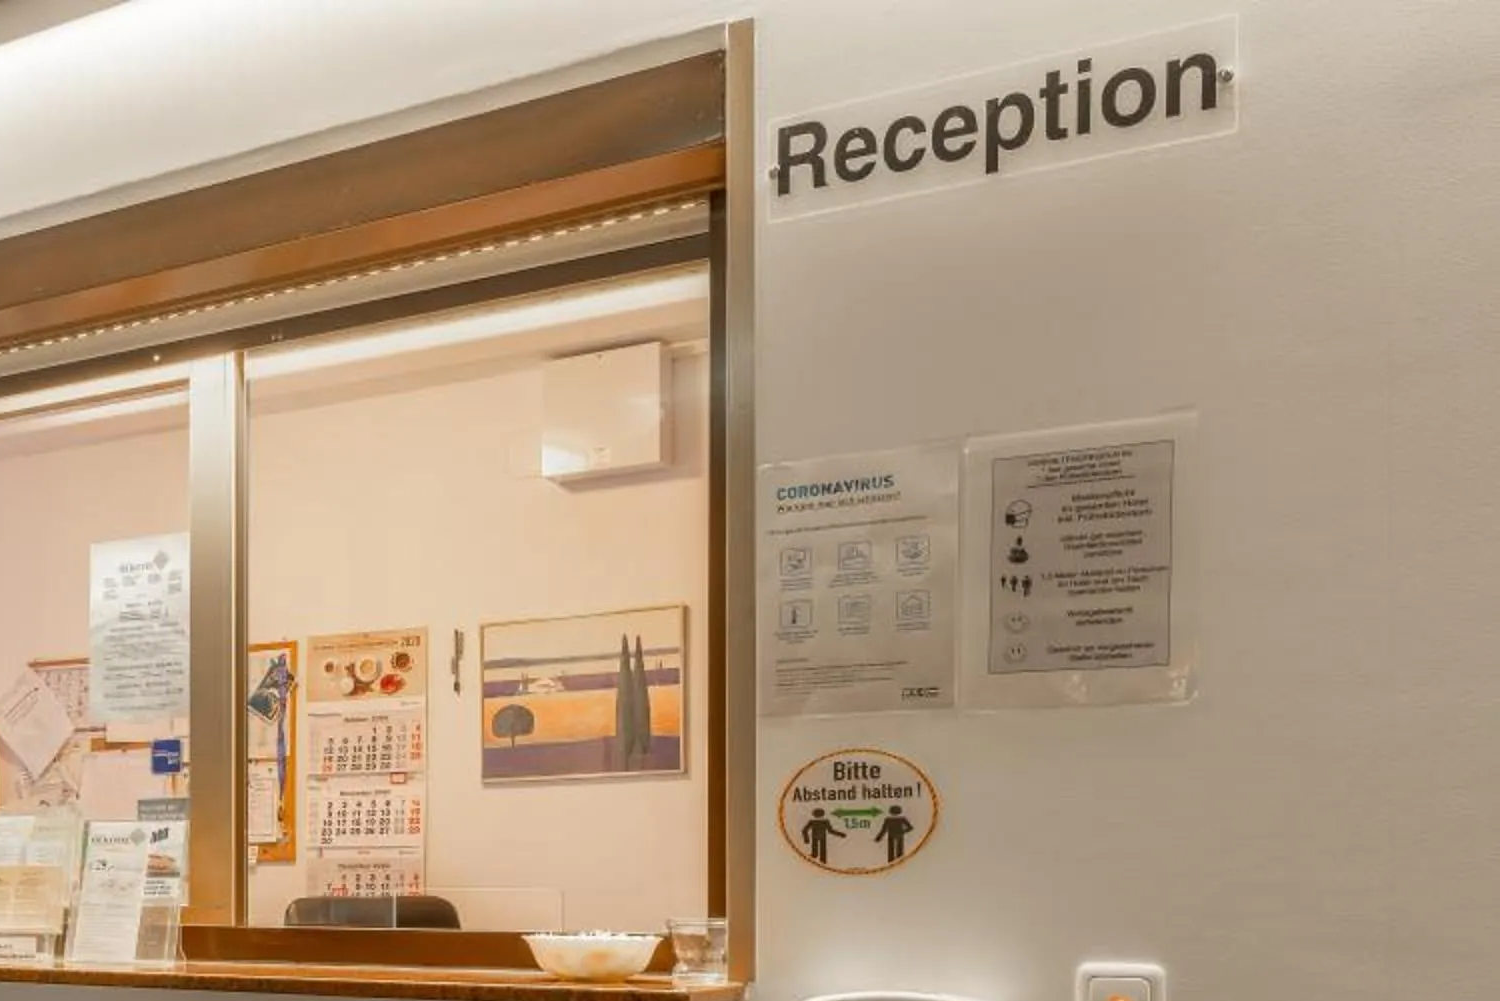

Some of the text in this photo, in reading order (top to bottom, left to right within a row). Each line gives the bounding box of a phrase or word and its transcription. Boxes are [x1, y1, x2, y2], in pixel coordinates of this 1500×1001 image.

[777, 51, 1217, 197] Reception
[776, 474, 895, 501] CORONAVIRUS
[833, 761, 882, 782] Bitte
[792, 785, 857, 803] Abstand
